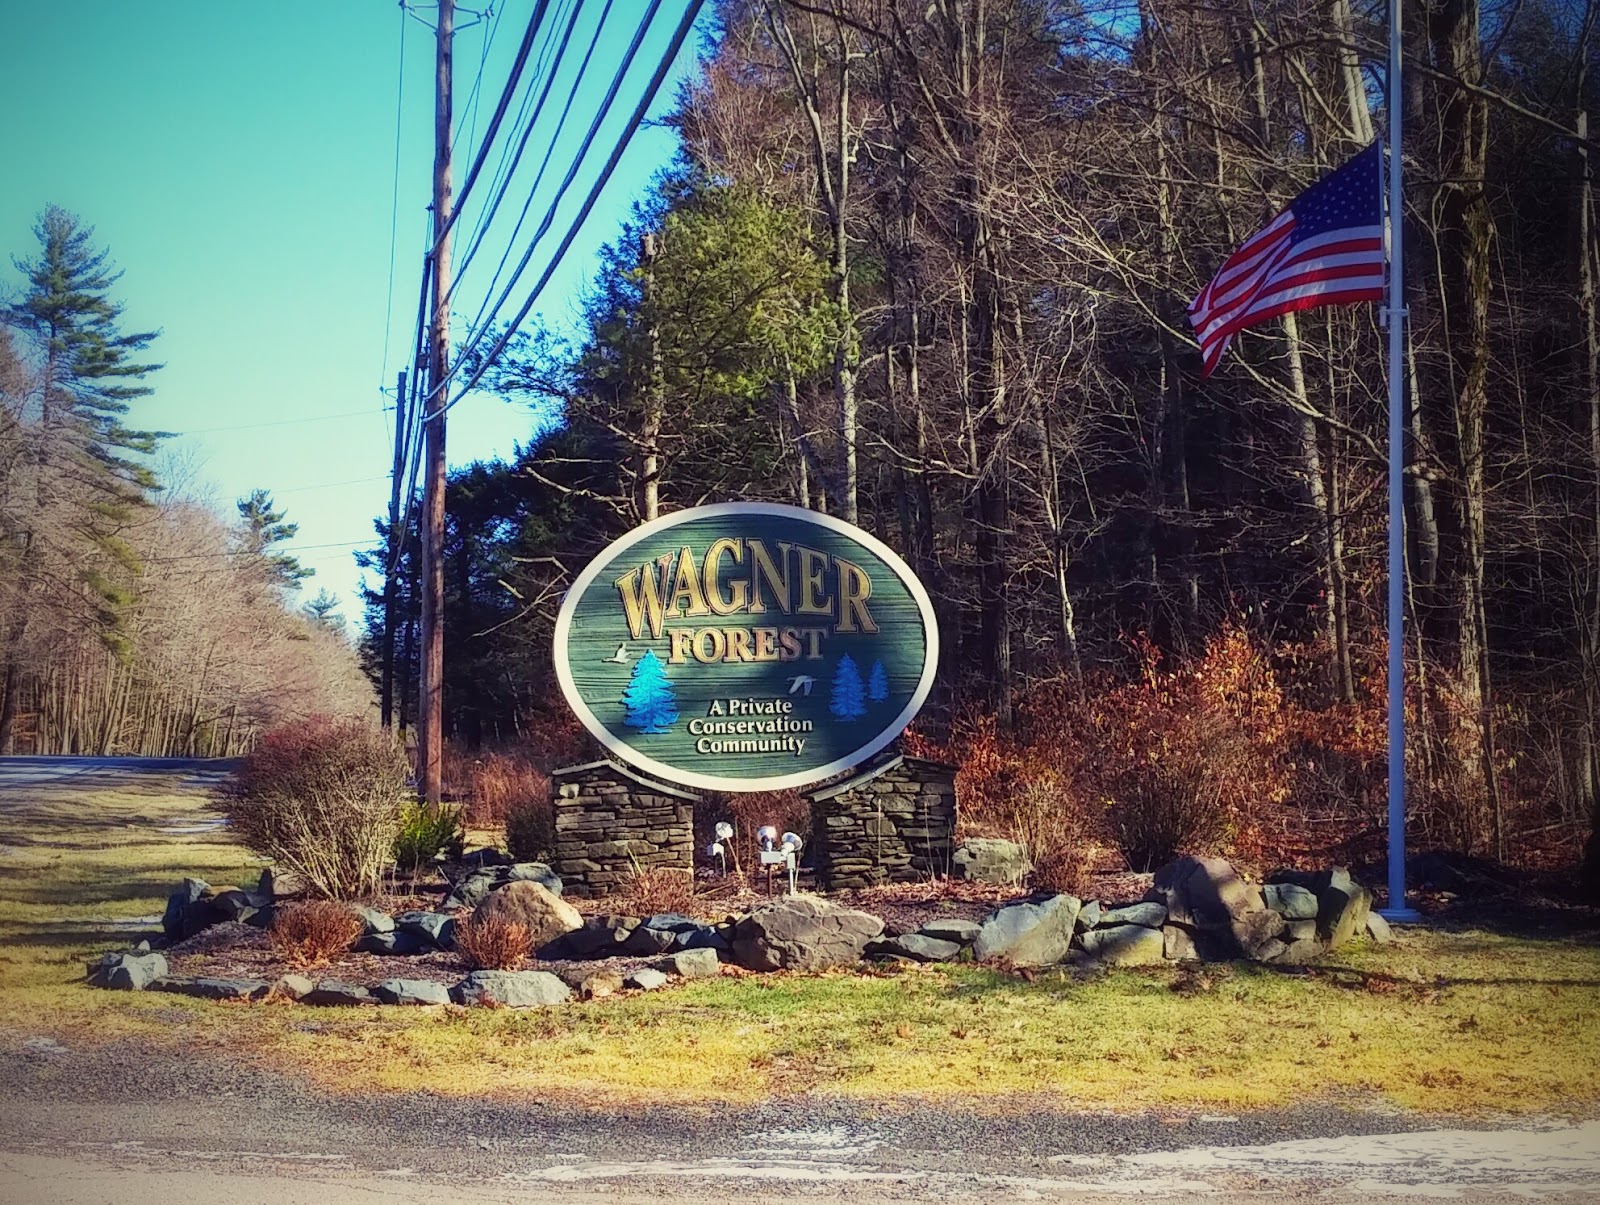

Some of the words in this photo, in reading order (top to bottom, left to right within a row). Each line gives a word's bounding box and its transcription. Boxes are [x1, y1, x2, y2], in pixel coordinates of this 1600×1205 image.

[615, 537, 879, 639] WAGNER
[667, 627, 829, 664] FOREST
[709, 700, 723, 715] A
[729, 698, 792, 715] Private
[689, 716, 813, 735] Conservation
[697, 735, 806, 756] Community
